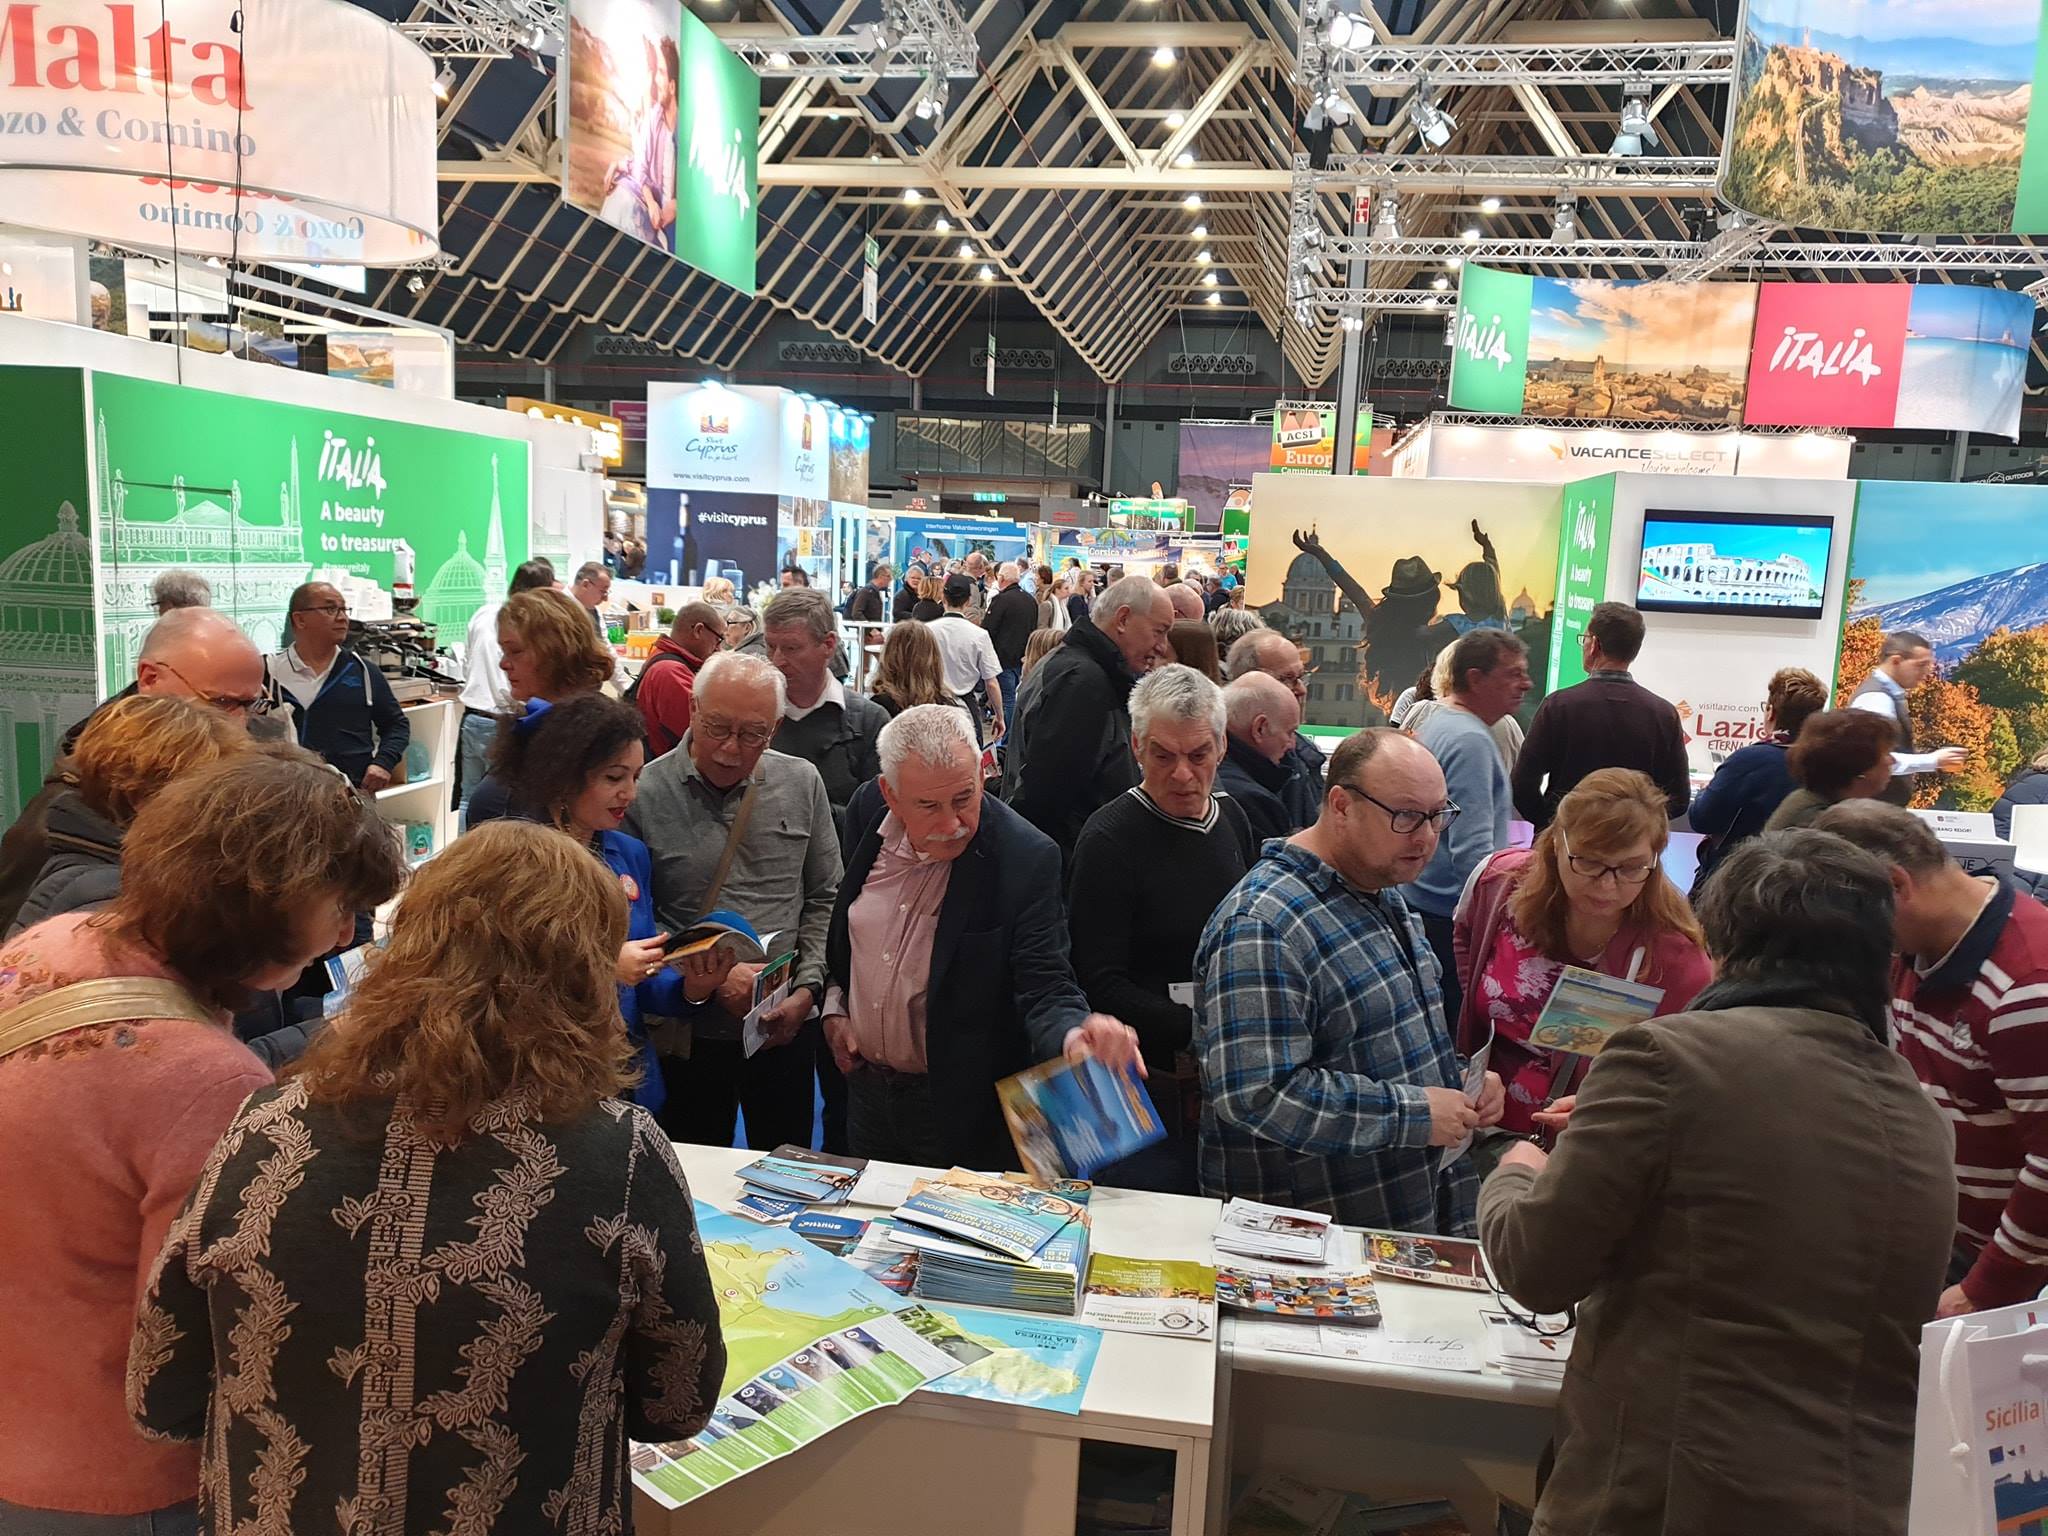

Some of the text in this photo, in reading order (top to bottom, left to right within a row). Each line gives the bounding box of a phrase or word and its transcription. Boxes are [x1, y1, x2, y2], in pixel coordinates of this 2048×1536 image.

[56, 106, 84, 136] &
[96, 109, 256, 156] Comino
[1287, 430, 1313, 441] ACSI
[685, 438, 738, 460] Cyprus
[1285, 450, 1333, 467] Europ
[673, 471, 750, 482] www.visitcyprus.com
[2005, 471, 2034, 481] OUTDOOR
[320, 500, 385, 528] A beauty
[698, 511, 768, 528] #visitcyprus
[320, 533, 338, 551] to
[1699, 703, 1759, 713] visitlazio.com
[1985, 1402, 2040, 1431] Sicilia
